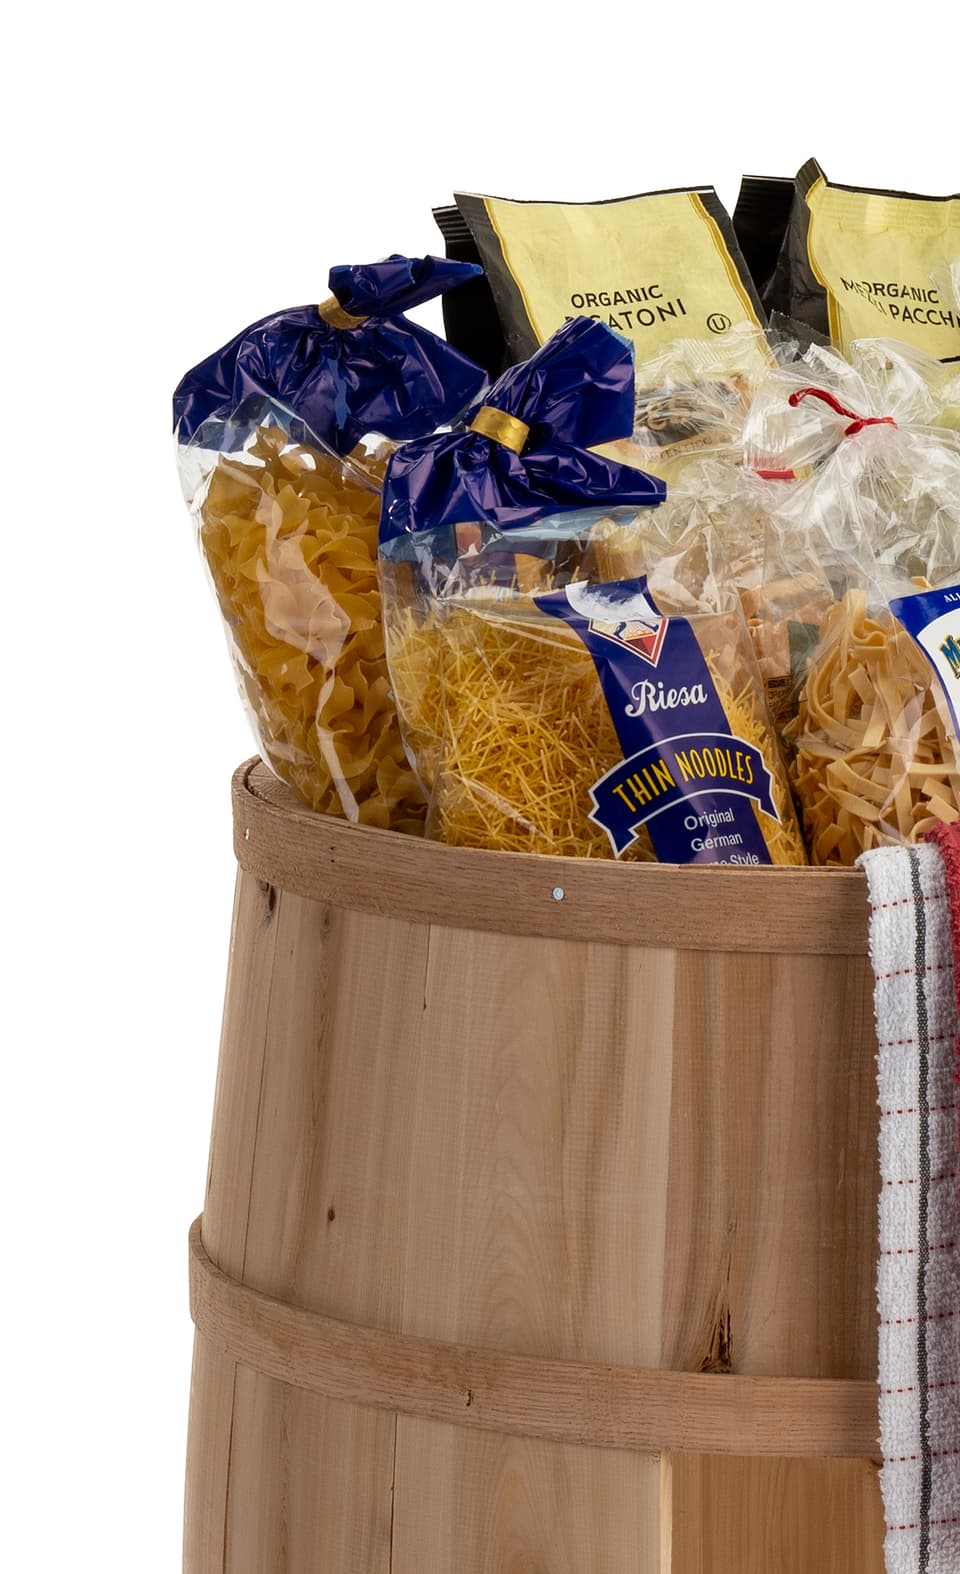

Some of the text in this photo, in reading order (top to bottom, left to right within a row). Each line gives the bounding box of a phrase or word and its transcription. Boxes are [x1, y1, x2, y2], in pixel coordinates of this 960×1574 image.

[570, 284, 664, 309] ORGANIC
[565, 298, 687, 331] ATONI
[624, 678, 708, 718] Riesa
[611, 747, 754, 813] THIN NOODLES
[683, 807, 735, 831] Original
[690, 831, 744, 853] German
